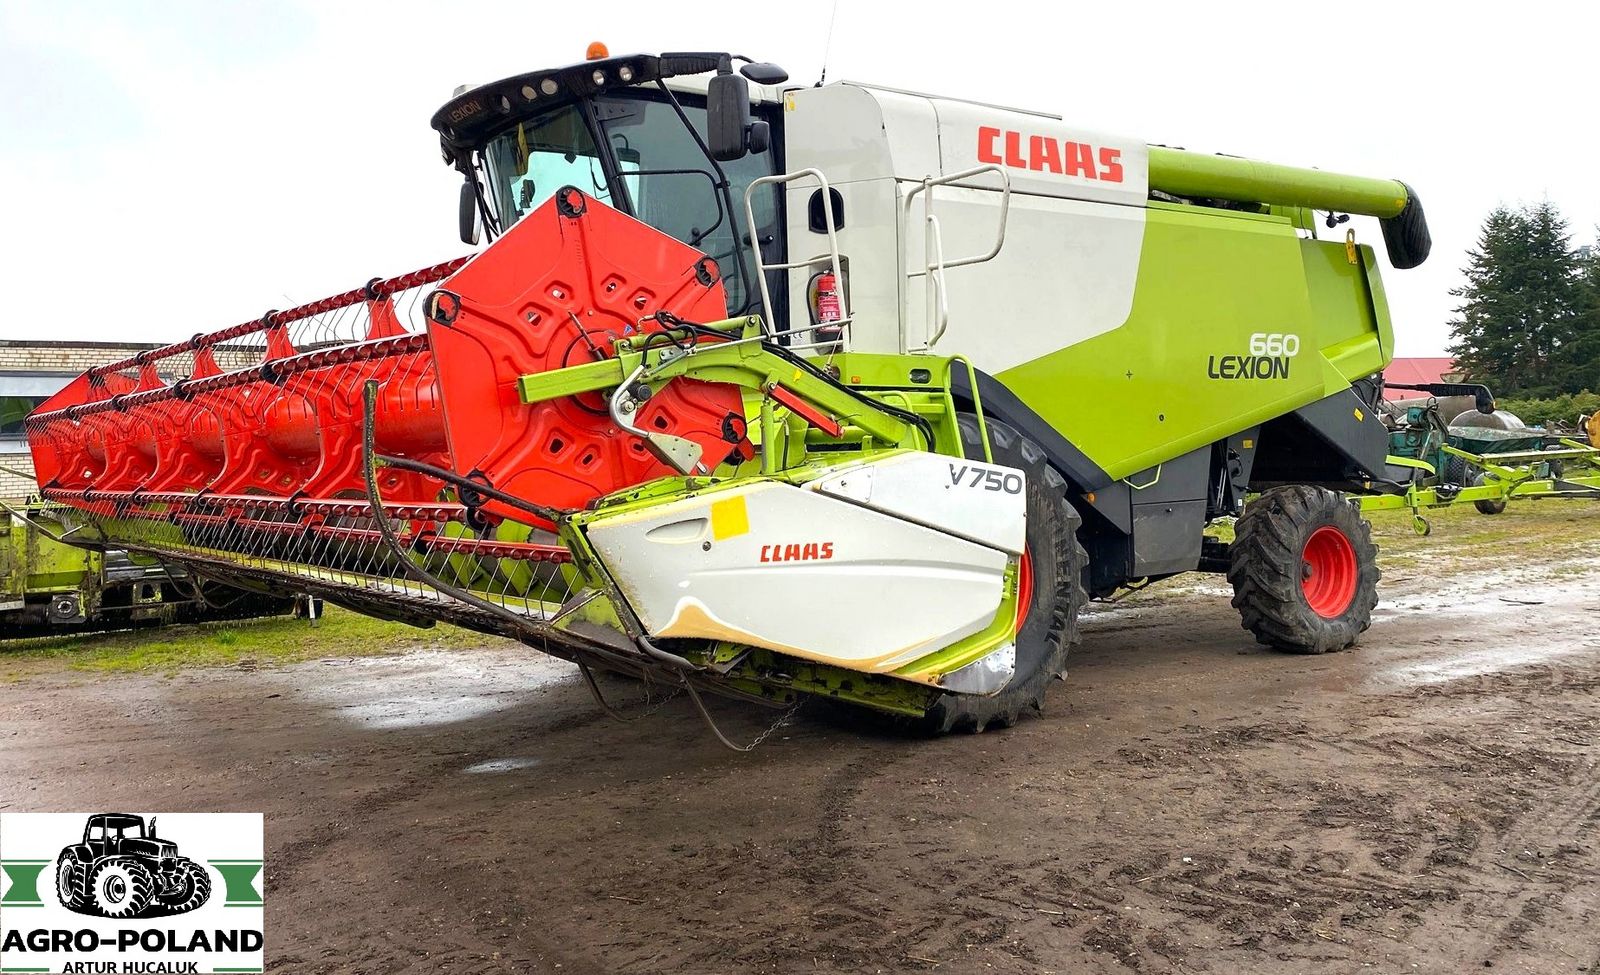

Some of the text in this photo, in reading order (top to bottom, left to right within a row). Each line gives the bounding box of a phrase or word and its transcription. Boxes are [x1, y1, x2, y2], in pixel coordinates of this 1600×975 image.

[448, 101, 482, 122] LEXION
[978, 126, 1123, 183] CLAAS
[1249, 333, 1300, 357] 660
[1207, 355, 1290, 379] LEXION
[949, 463, 1023, 495] V 750
[760, 542, 833, 562] CLAAS
